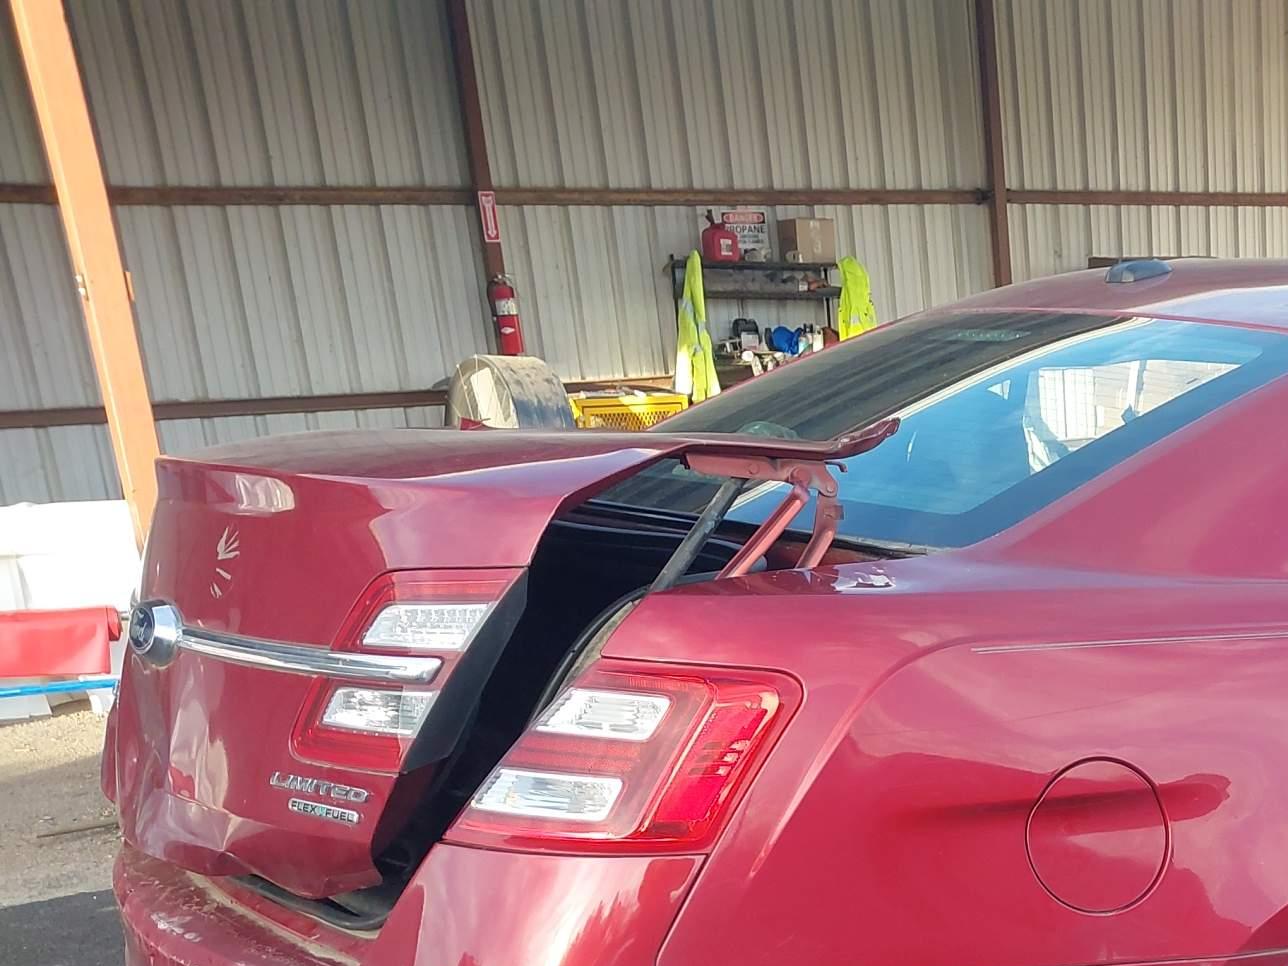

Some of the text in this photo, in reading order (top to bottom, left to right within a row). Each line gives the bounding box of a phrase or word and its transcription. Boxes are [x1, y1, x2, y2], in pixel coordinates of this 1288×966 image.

[269, 771, 369, 803] LIMITED
[290, 799, 356, 823] FLEX FUEL
